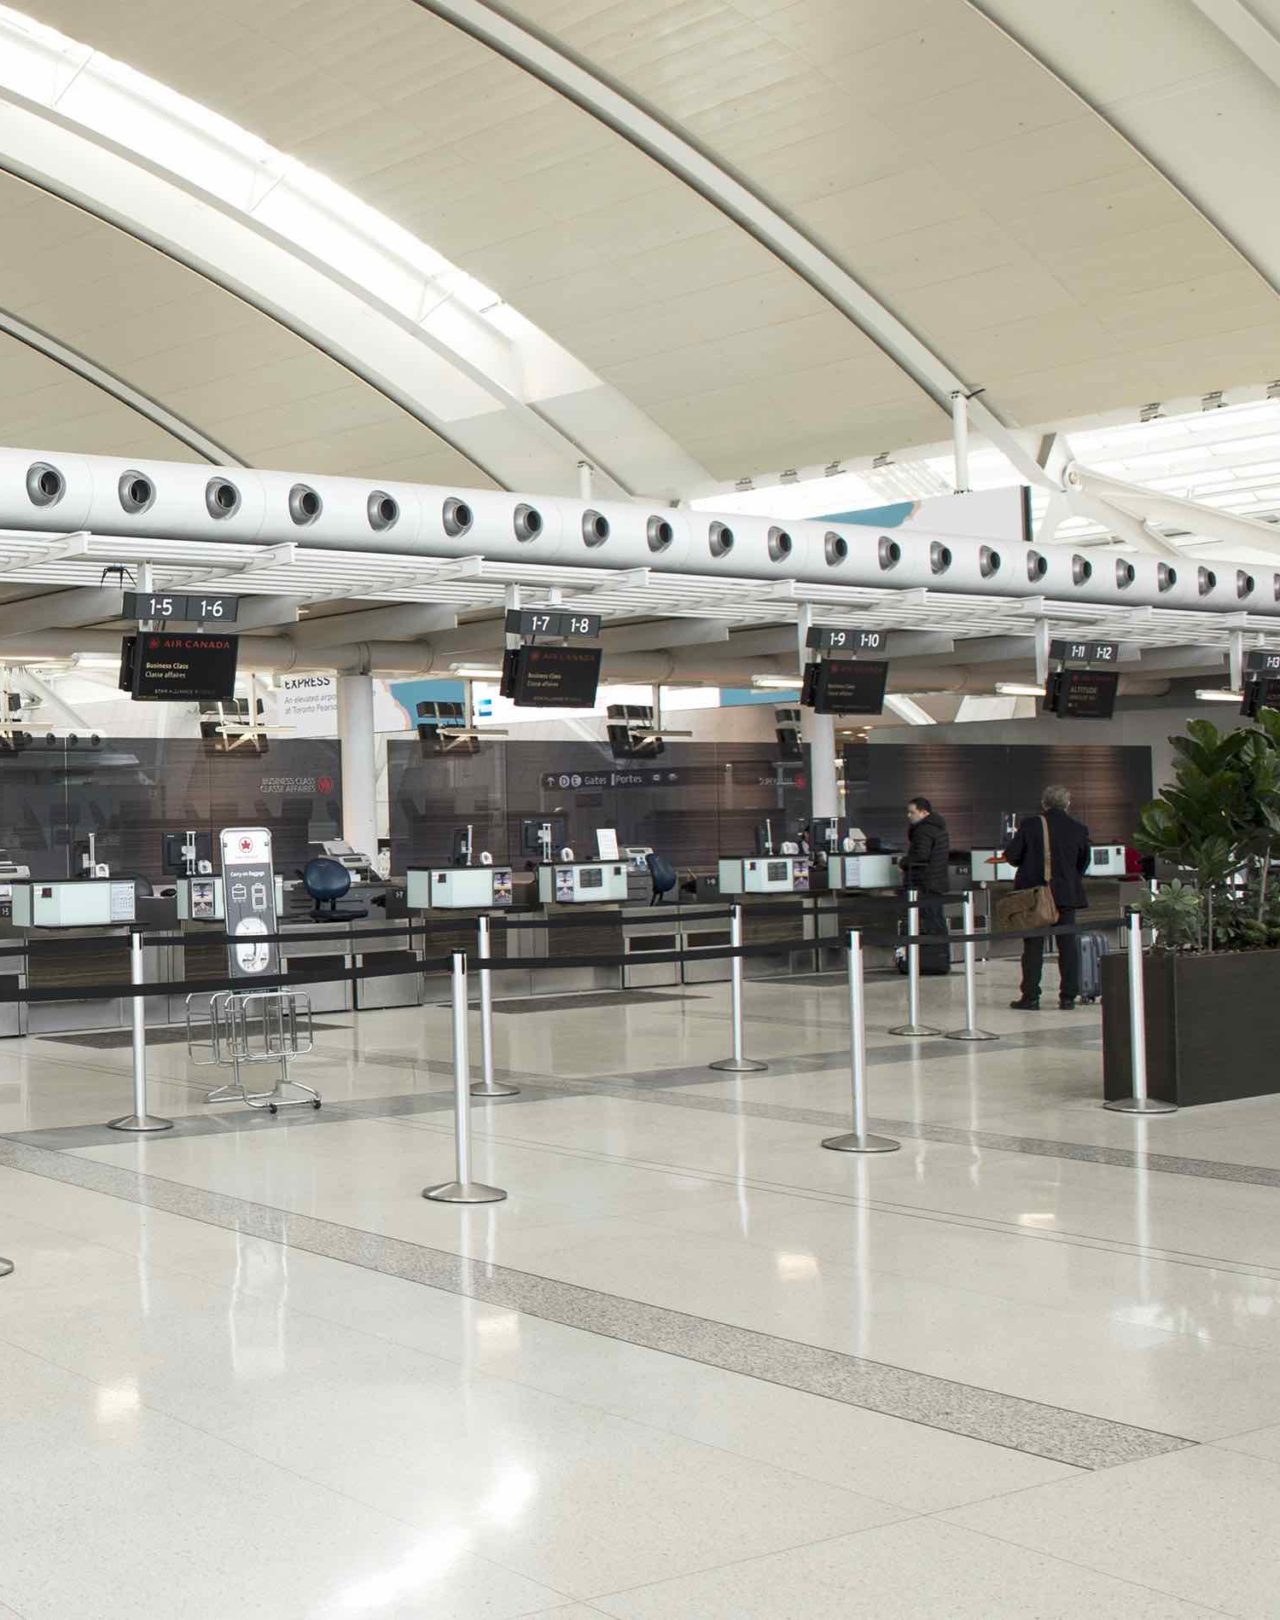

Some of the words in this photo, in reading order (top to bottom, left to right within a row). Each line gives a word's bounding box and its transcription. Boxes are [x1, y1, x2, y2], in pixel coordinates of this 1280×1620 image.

[150, 598, 173, 616] 1-5
[201, 600, 223, 617] 1-6
[532, 616, 550, 632] 1-7
[570, 618, 589, 633] 1-8
[164, 640, 183, 648] AIR
[185, 641, 230, 649] CANADA
[830, 632, 846, 646] 1-9
[860, 634, 879, 647] 1-10
[1071, 646, 1086, 657] 1-11
[1096, 647, 1112, 659] 1-12
[284, 676, 331, 689] EXPRESS
[584, 776, 608, 785] Gates
[616, 774, 642, 784] Portes
